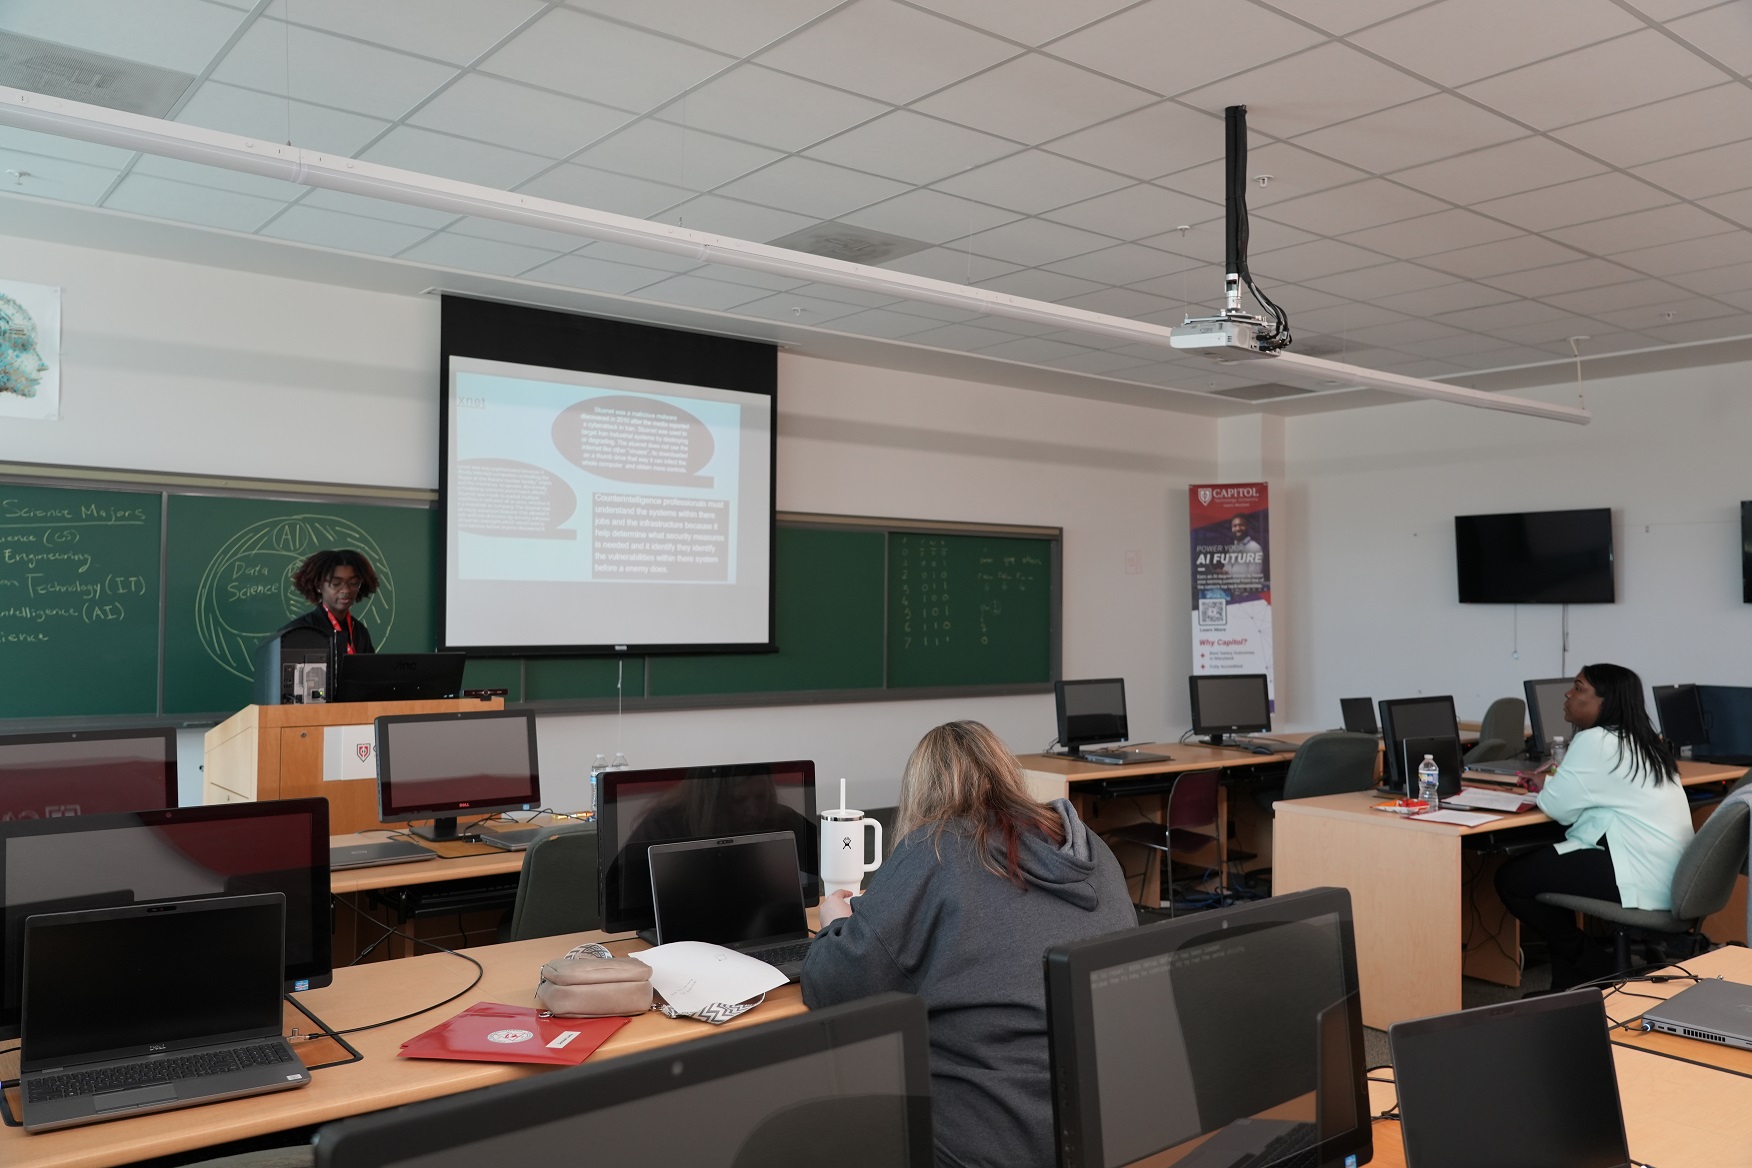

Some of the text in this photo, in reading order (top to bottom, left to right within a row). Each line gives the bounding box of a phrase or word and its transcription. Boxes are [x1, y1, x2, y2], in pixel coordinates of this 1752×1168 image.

[643, 418, 652, 426] the
[1213, 488, 1259, 498] CAPITOL
[595, 494, 662, 506] Counterintelligence
[663, 498, 706, 508] professionals
[2, 499, 146, 525] Science Majors
[595, 505, 716, 519] understand the systems within there
[594, 516, 718, 530] jobs and the infrastructure because it
[281, 523, 300, 551] AI
[595, 529, 610, 538] help
[612, 530, 648, 538] determine
[666, 532, 692, 542] security
[692, 534, 725, 542] measures
[595, 540, 716, 554] is needed and it identify they identify
[3, 548, 92, 573] Engineering
[595, 552, 718, 564] the vulnerabilities within there system
[1196, 552, 1262, 565] AI FUTURE
[233, 561, 269, 580] Data
[595, 563, 618, 572] before
[626, 566, 650, 575] enemy
[25, 573, 101, 600] Technology
[105, 573, 147, 597] (IT)
[227, 582, 280, 602] Science
[82, 602, 125, 624] (AI)
[1199, 637, 1248, 648] Why Capitol?
